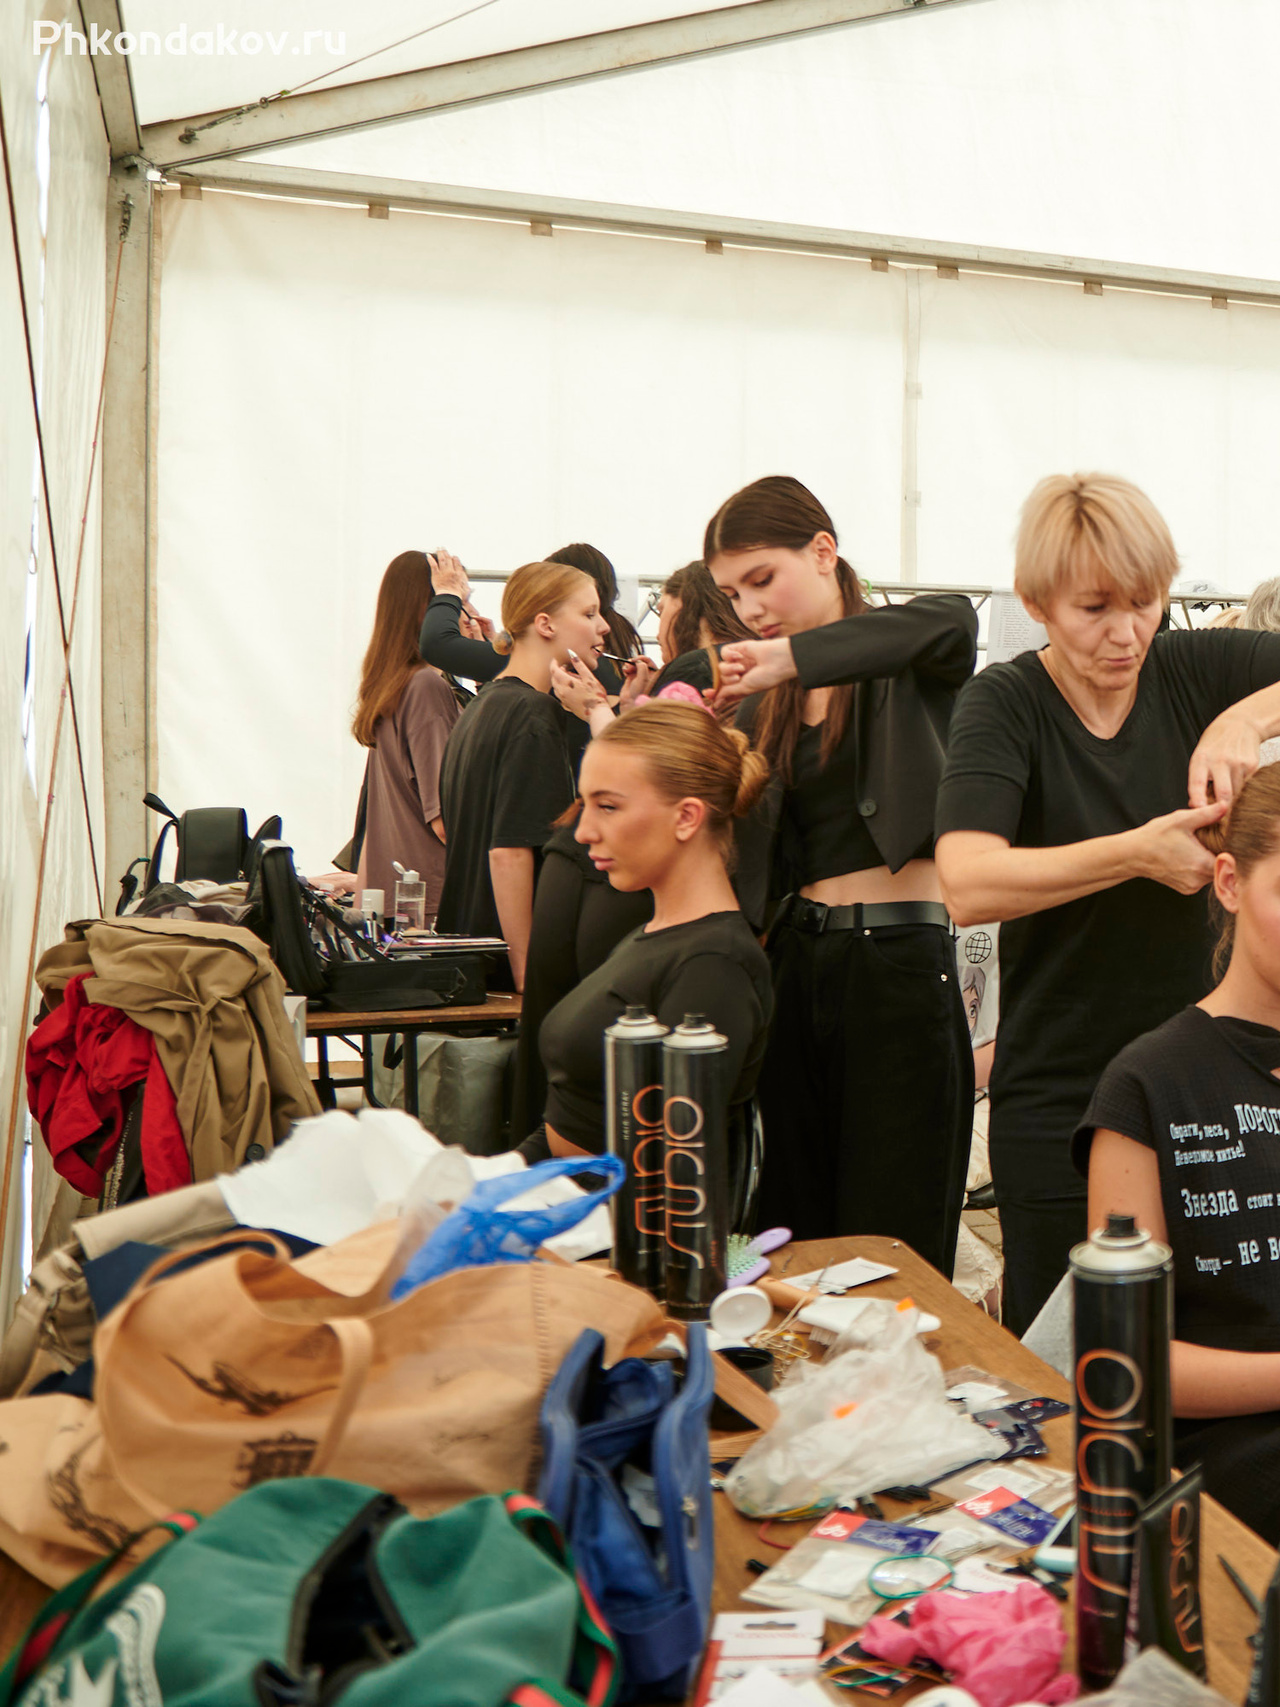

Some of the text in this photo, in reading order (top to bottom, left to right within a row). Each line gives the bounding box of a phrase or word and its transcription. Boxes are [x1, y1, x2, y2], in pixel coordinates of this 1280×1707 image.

[621, 1120, 630, 1141] HAIR
[1180, 1188, 1240, 1219] Звезда
[1247, 1193, 1274, 1210] стоит
[1237, 1239, 1262, 1266] не
